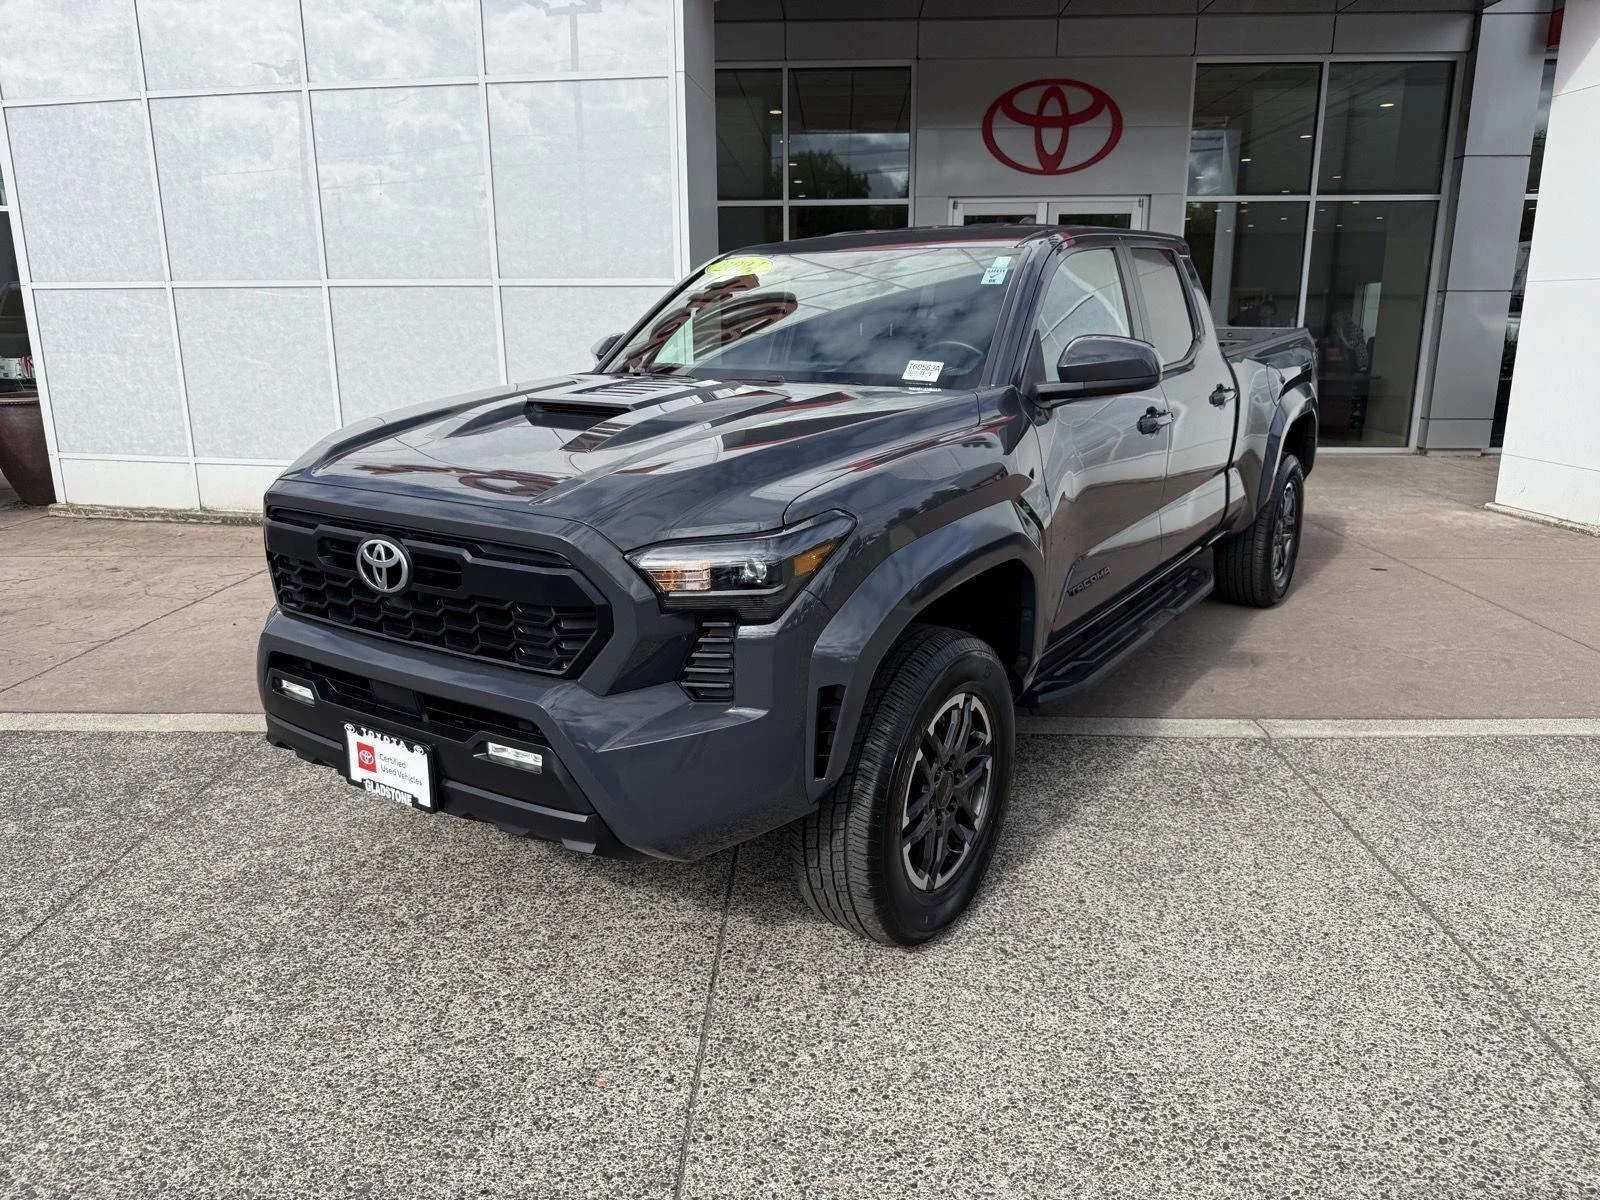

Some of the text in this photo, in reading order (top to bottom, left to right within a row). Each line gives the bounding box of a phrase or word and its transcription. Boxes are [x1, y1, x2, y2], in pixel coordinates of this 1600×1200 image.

[1067, 566, 1112, 597] TACOMA
[360, 727, 407, 748] TOYOTA
[379, 753, 407, 768] Certified
[380, 764, 423, 787] Used Vehicles
[364, 779, 413, 806] GLADSTONE
